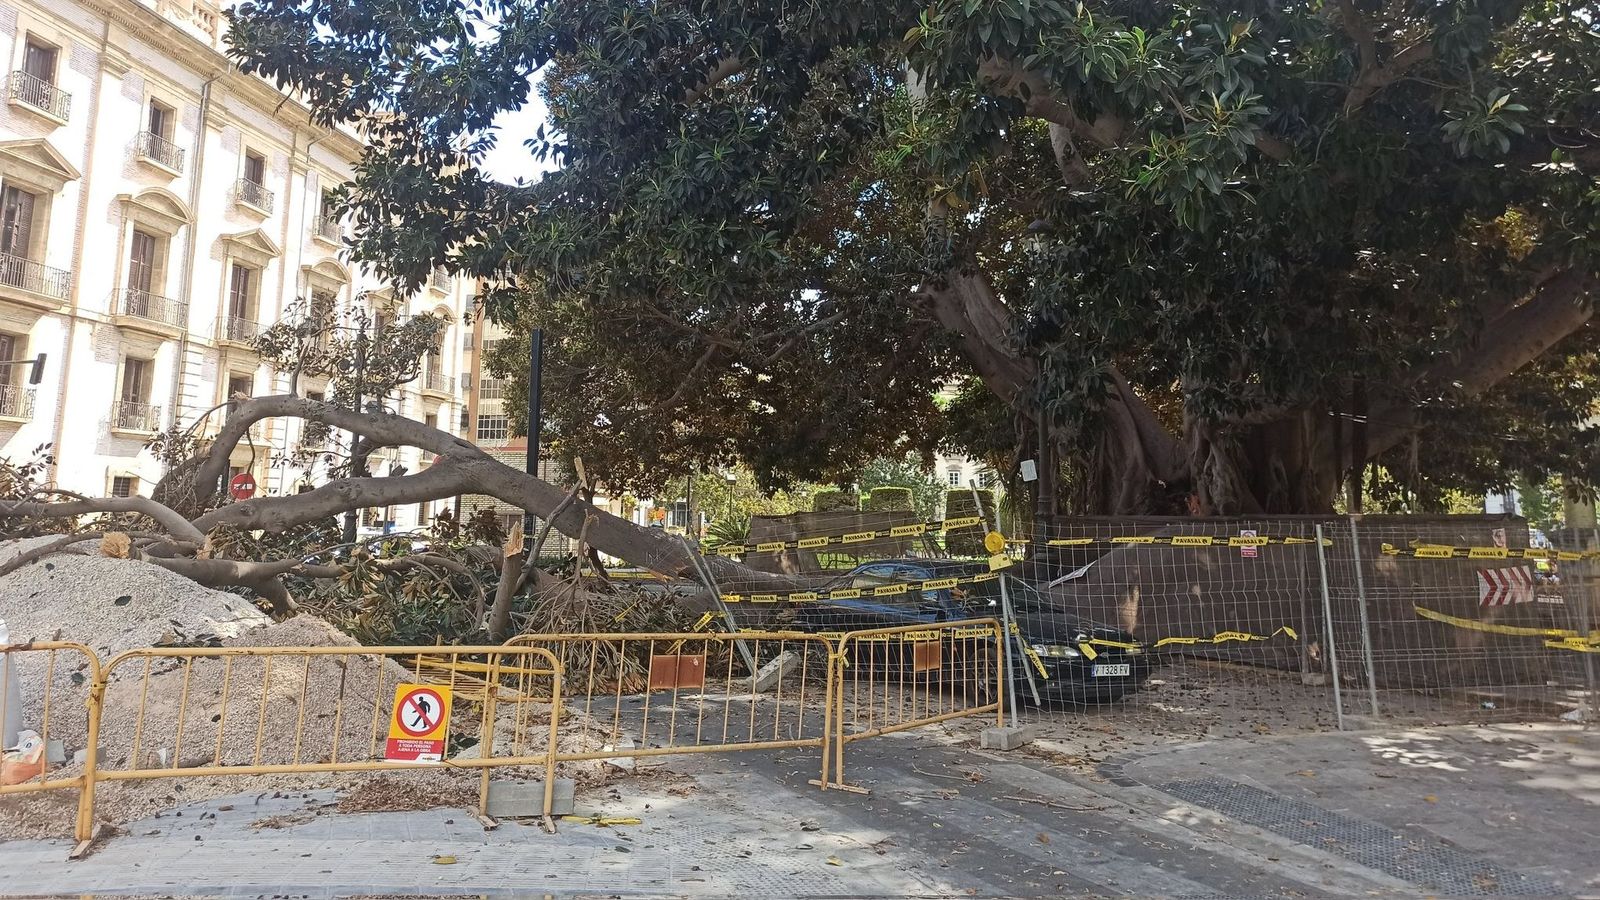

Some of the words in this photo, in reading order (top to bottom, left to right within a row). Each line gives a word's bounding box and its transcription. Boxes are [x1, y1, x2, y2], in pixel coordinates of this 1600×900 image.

[945, 519, 969, 527] PAVASAL
[893, 527, 915, 535] PAVASAL
[845, 533, 866, 541] PAVASAL
[1102, 665, 1118, 675] 1328
